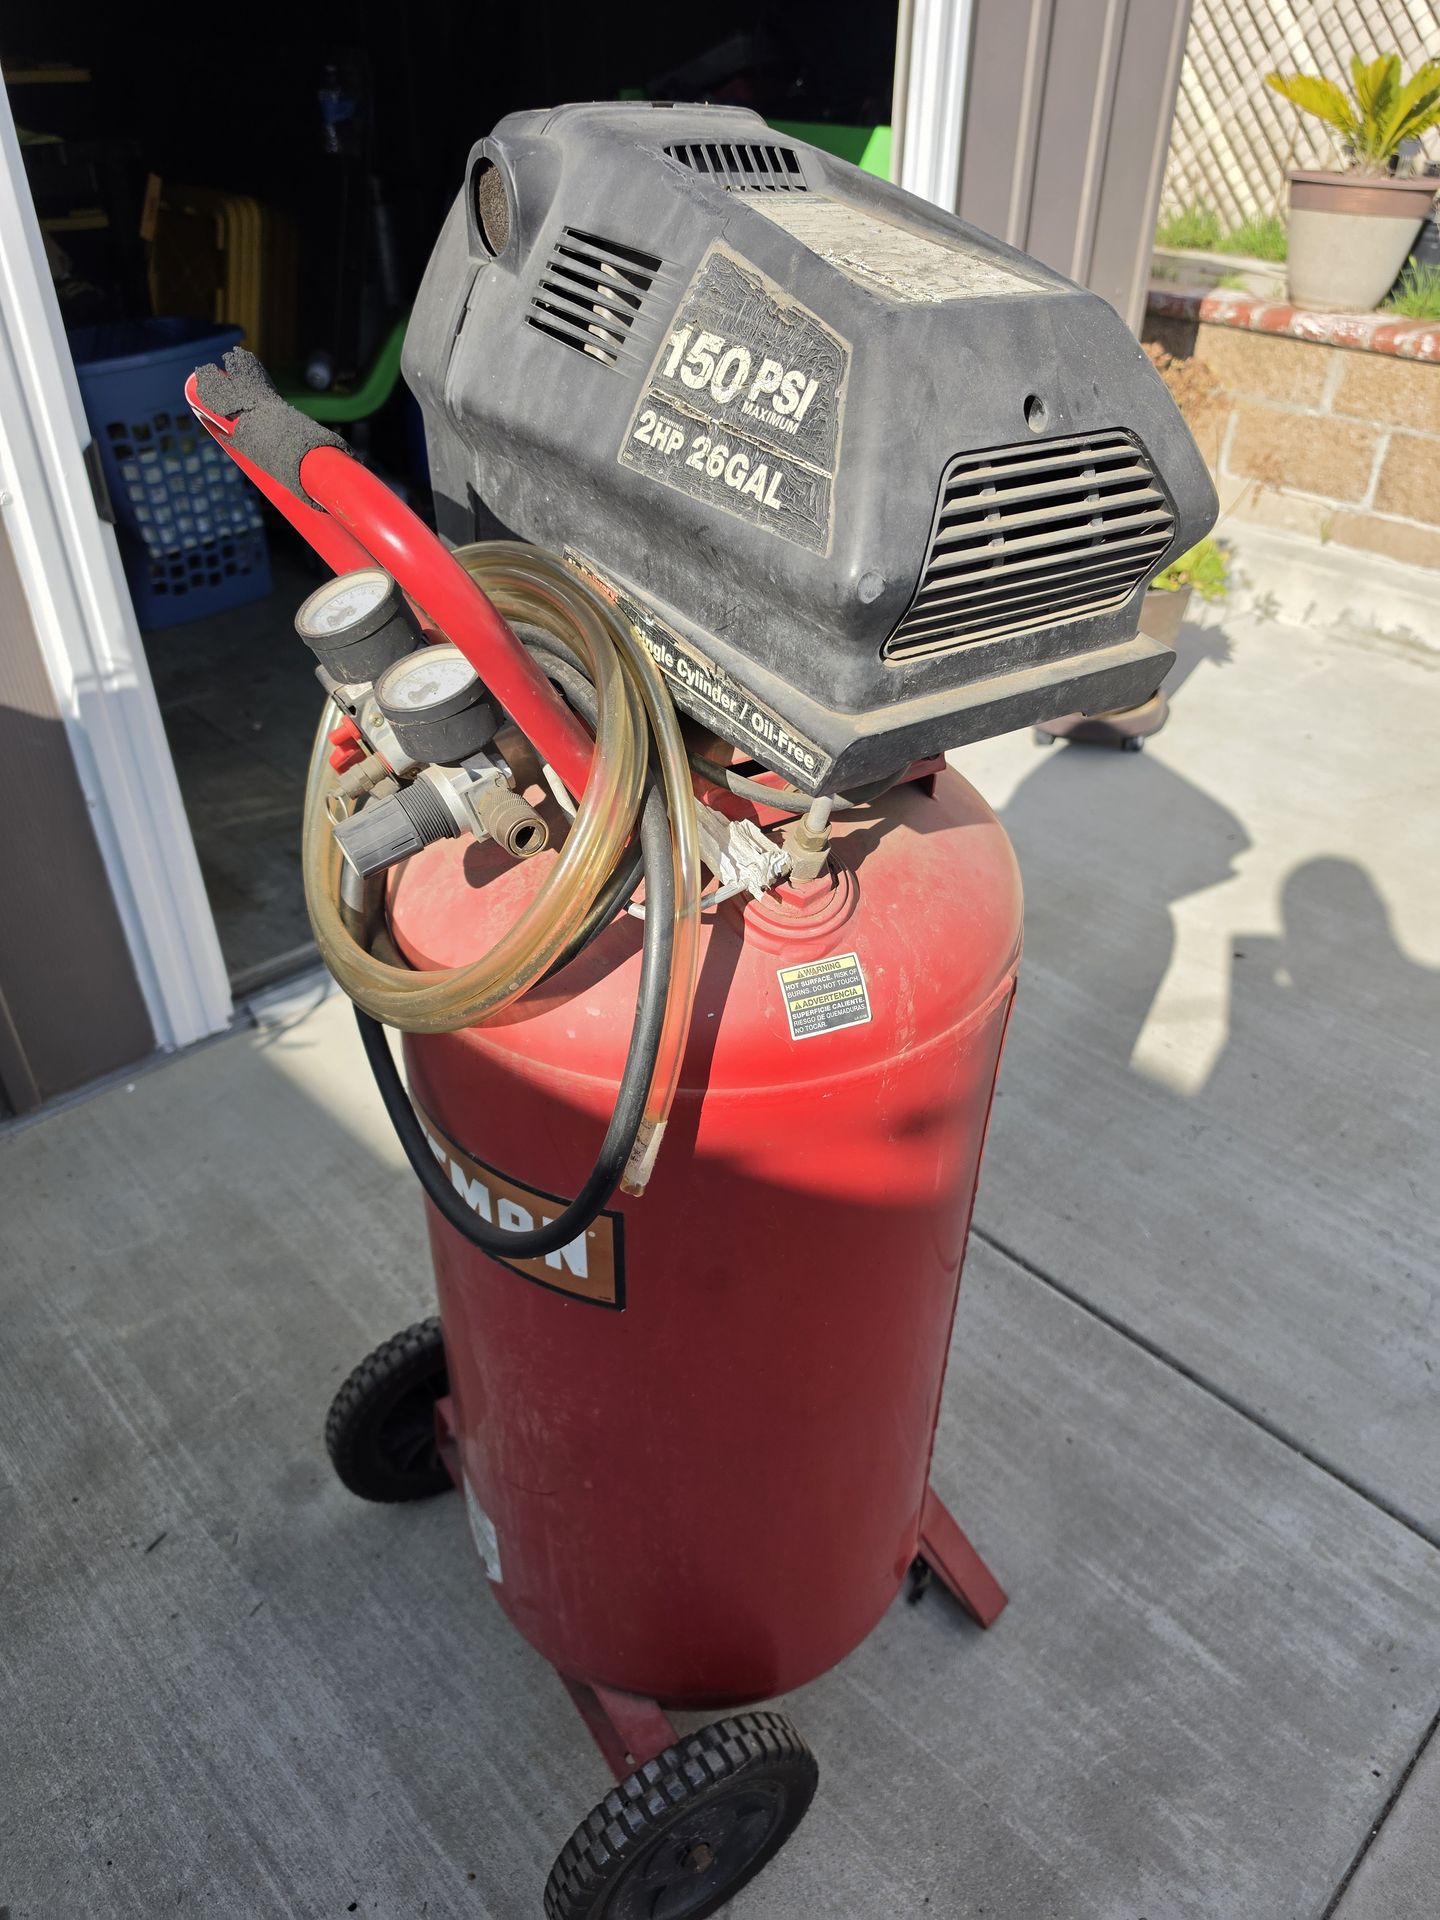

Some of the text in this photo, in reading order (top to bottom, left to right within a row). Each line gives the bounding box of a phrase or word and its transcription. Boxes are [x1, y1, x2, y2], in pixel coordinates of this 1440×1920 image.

[663, 321, 820, 421] 150 PSI
[659, 415, 684, 431] RUNNING
[741, 400, 800, 435] MAXIMUM
[633, 410, 784, 510] 2HP 26GAL
[677, 658, 738, 713] Cylinder
[739, 702, 749, 720] /
[751, 712, 815, 770] Oil-Free
[803, 961, 842, 977] WARNING
[785, 982, 799, 991] HOT
[801, 974, 833, 987] SURFACE.
[833, 971, 849, 979] RISK
[787, 987, 812, 999] BURNS.
[812, 985, 822, 993] DO
[823, 981, 836, 990] NOT
[792, 996, 865, 1020] SUPERFICIE CALIENTE.
[802, 987, 858, 1008] ADVERTENCIA
[793, 1016, 816, 1027] RIESGO
[826, 1003, 866, 1019] QUEMADURAS.
[794, 1026, 804, 1034] NO
